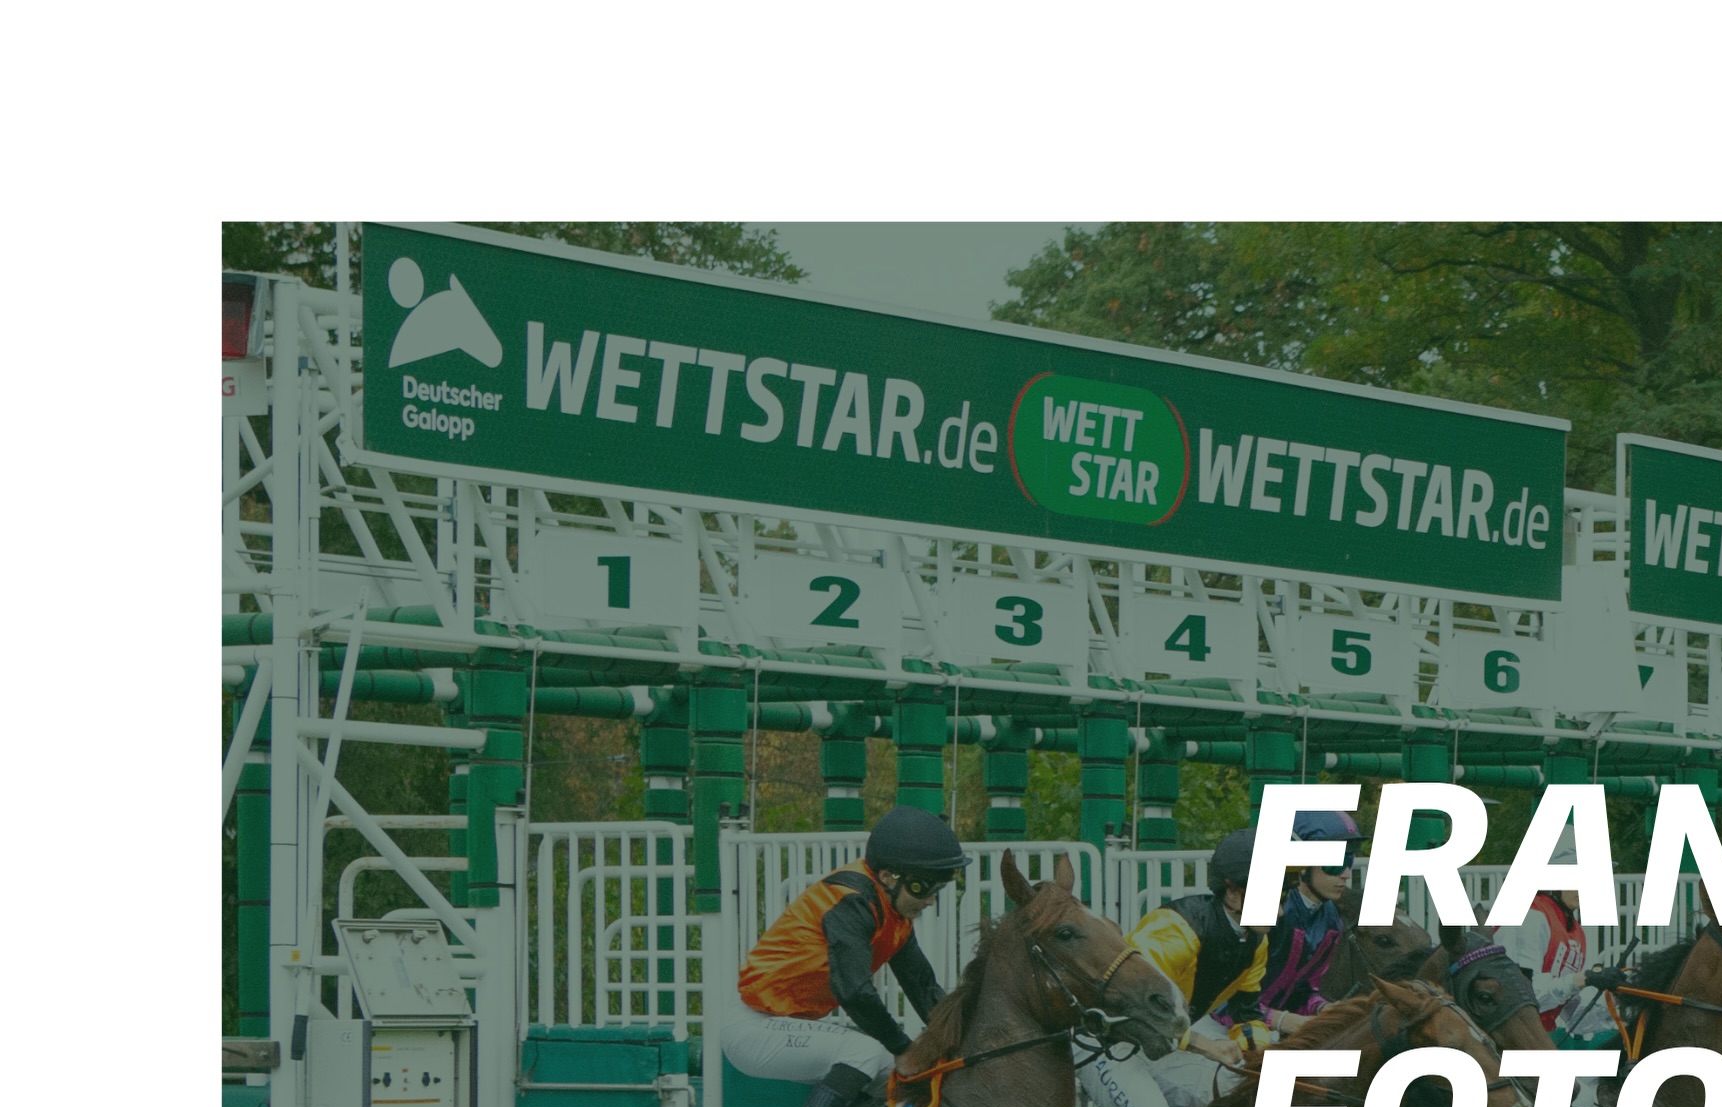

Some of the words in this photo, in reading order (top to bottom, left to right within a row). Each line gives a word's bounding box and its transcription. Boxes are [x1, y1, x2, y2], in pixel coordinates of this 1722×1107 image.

[403, 375, 502, 412] Deutscher
[526, 320, 998, 474] WETTSTAR.de
[402, 404, 475, 441] Galopp
[1043, 396, 1143, 452] WETT
[1069, 452, 1159, 505] STAR
[1199, 428, 1549, 549] WETTSTAR.de
[597, 555, 631, 609] 1
[809, 575, 861, 629] 2
[994, 595, 1044, 647] 3
[1164, 614, 1211, 662] 4
[1331, 628, 1372, 676] 5
[1483, 649, 1520, 694] 6
[786, 1034, 811, 1048] KGZ
